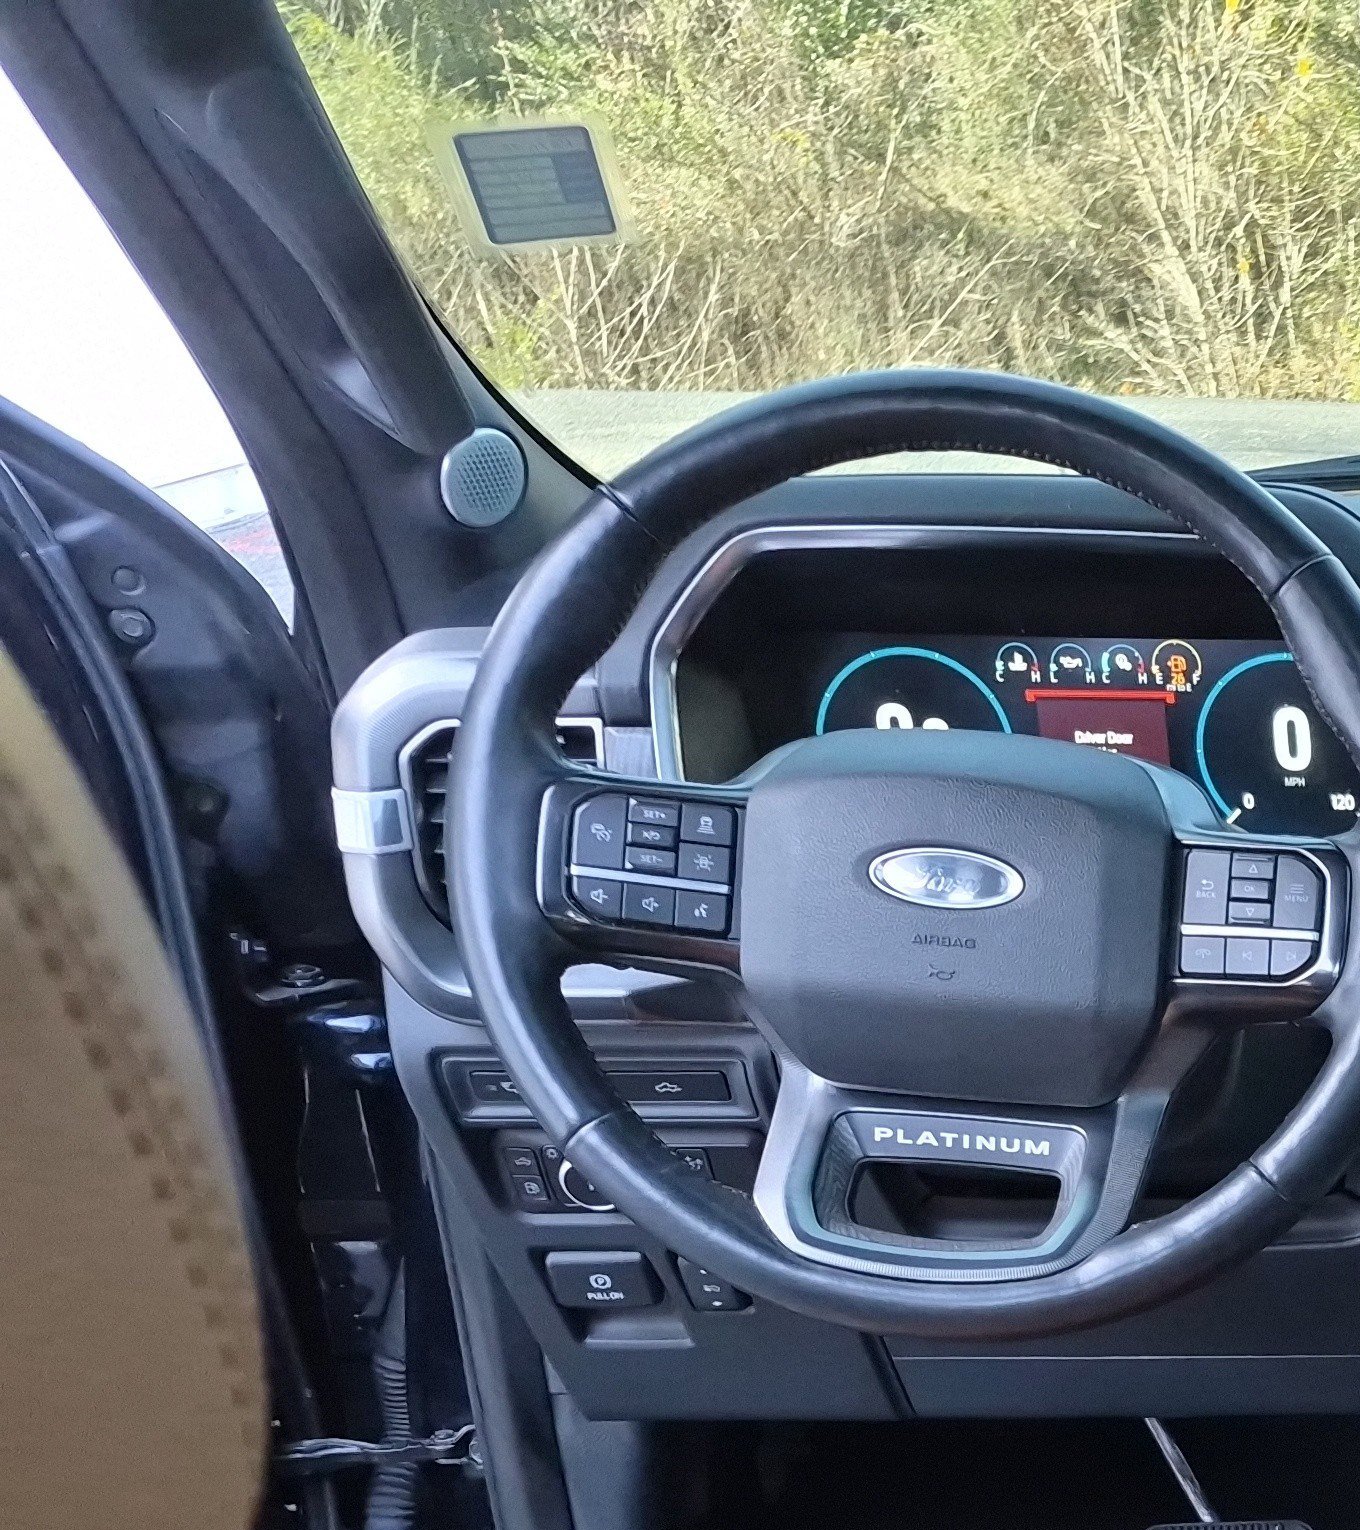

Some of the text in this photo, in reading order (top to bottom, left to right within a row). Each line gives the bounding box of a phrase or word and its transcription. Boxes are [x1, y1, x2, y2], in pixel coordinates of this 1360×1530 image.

[995, 671, 1005, 683] C
[1031, 671, 1041, 683] H
[1050, 671, 1058, 683] L
[1086, 671, 1096, 684] H
[1102, 671, 1111, 684] C
[1138, 671, 1148, 684] H
[1156, 672, 1164, 684] E
[1192, 673, 1201, 685] F
[1074, 730, 1134, 745] Driver Door
[1273, 706, 1311, 772] 0
[1284, 776, 1306, 787] MPH
[1242, 792, 1255, 810] 0
[1329, 793, 1356, 811] 120
[1196, 890, 1216, 899] BACK
[1284, 894, 1309, 903] MENU
[912, 932, 977, 949] AIRBAG
[873, 1125, 1050, 1156] PLATINUM
[587, 1292, 610, 1300] PULL
